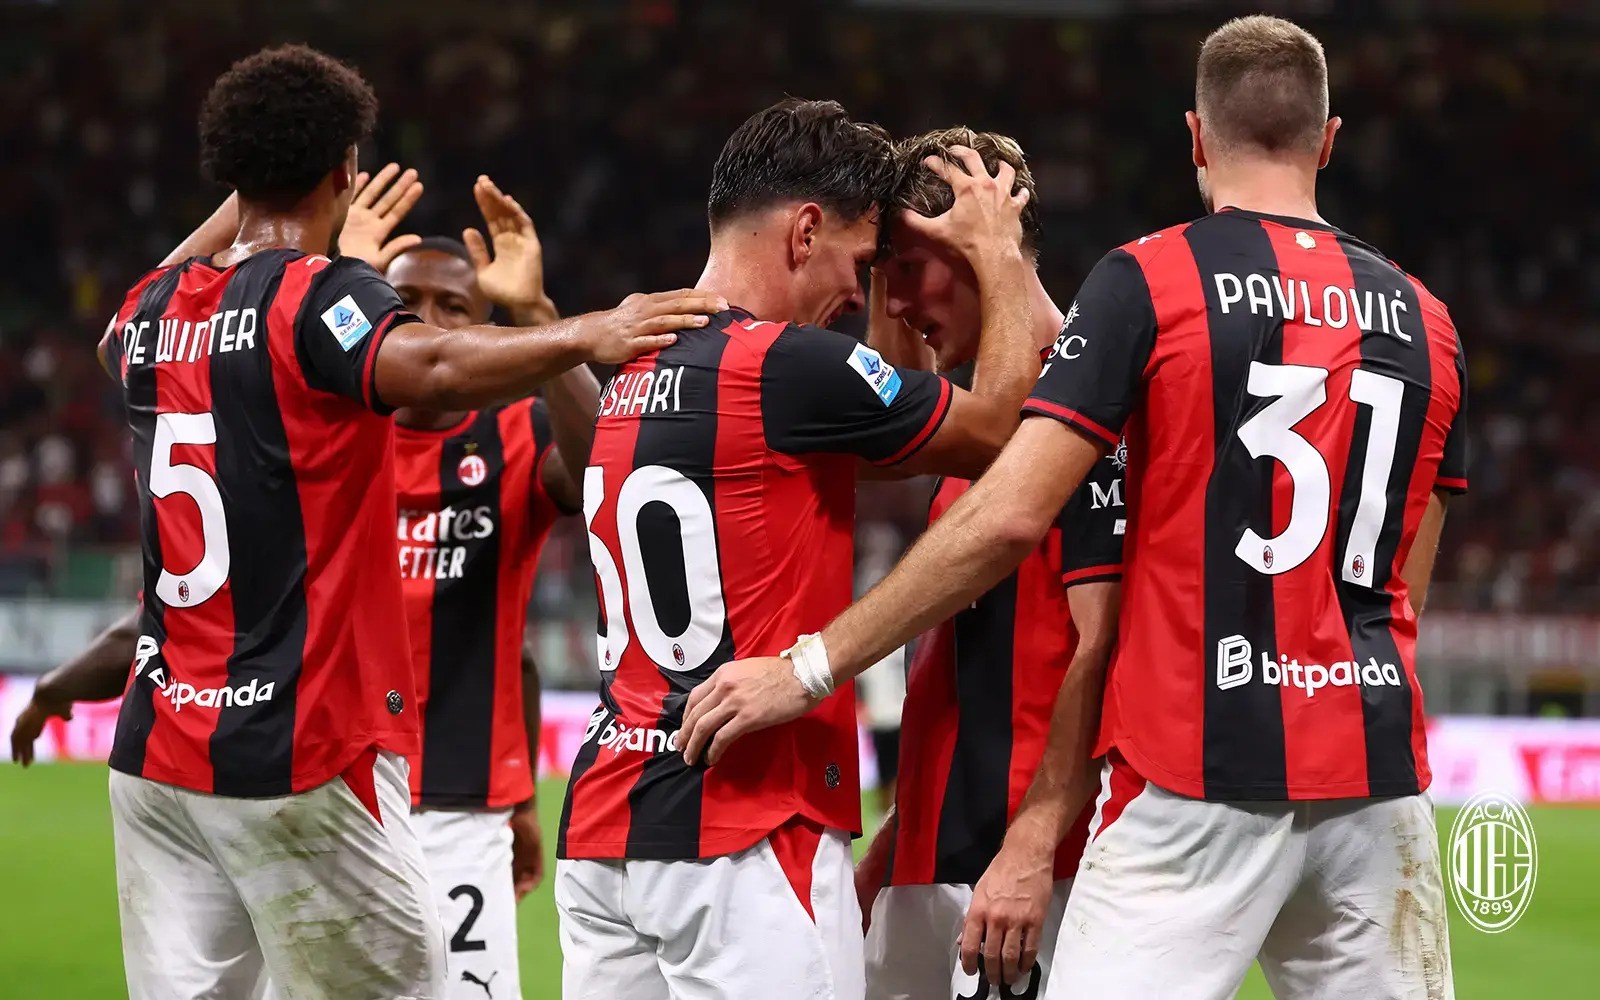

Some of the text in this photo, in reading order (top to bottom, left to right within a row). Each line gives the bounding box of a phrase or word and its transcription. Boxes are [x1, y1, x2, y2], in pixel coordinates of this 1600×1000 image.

[123, 307, 257, 365] DE WINTER
[1213, 272, 1412, 343] PAVLOVIĆ
[1047, 334, 1088, 360] SC
[596, 365, 685, 417] ASHARI
[1234, 360, 1405, 588] 31
[149, 411, 231, 608] 5
[397, 505, 494, 542] rates
[398, 546, 467, 580] ETTER
[582, 464, 726, 672] 30
[1261, 651, 1402, 699] bitpanda
[447, 884, 487, 953] 2
